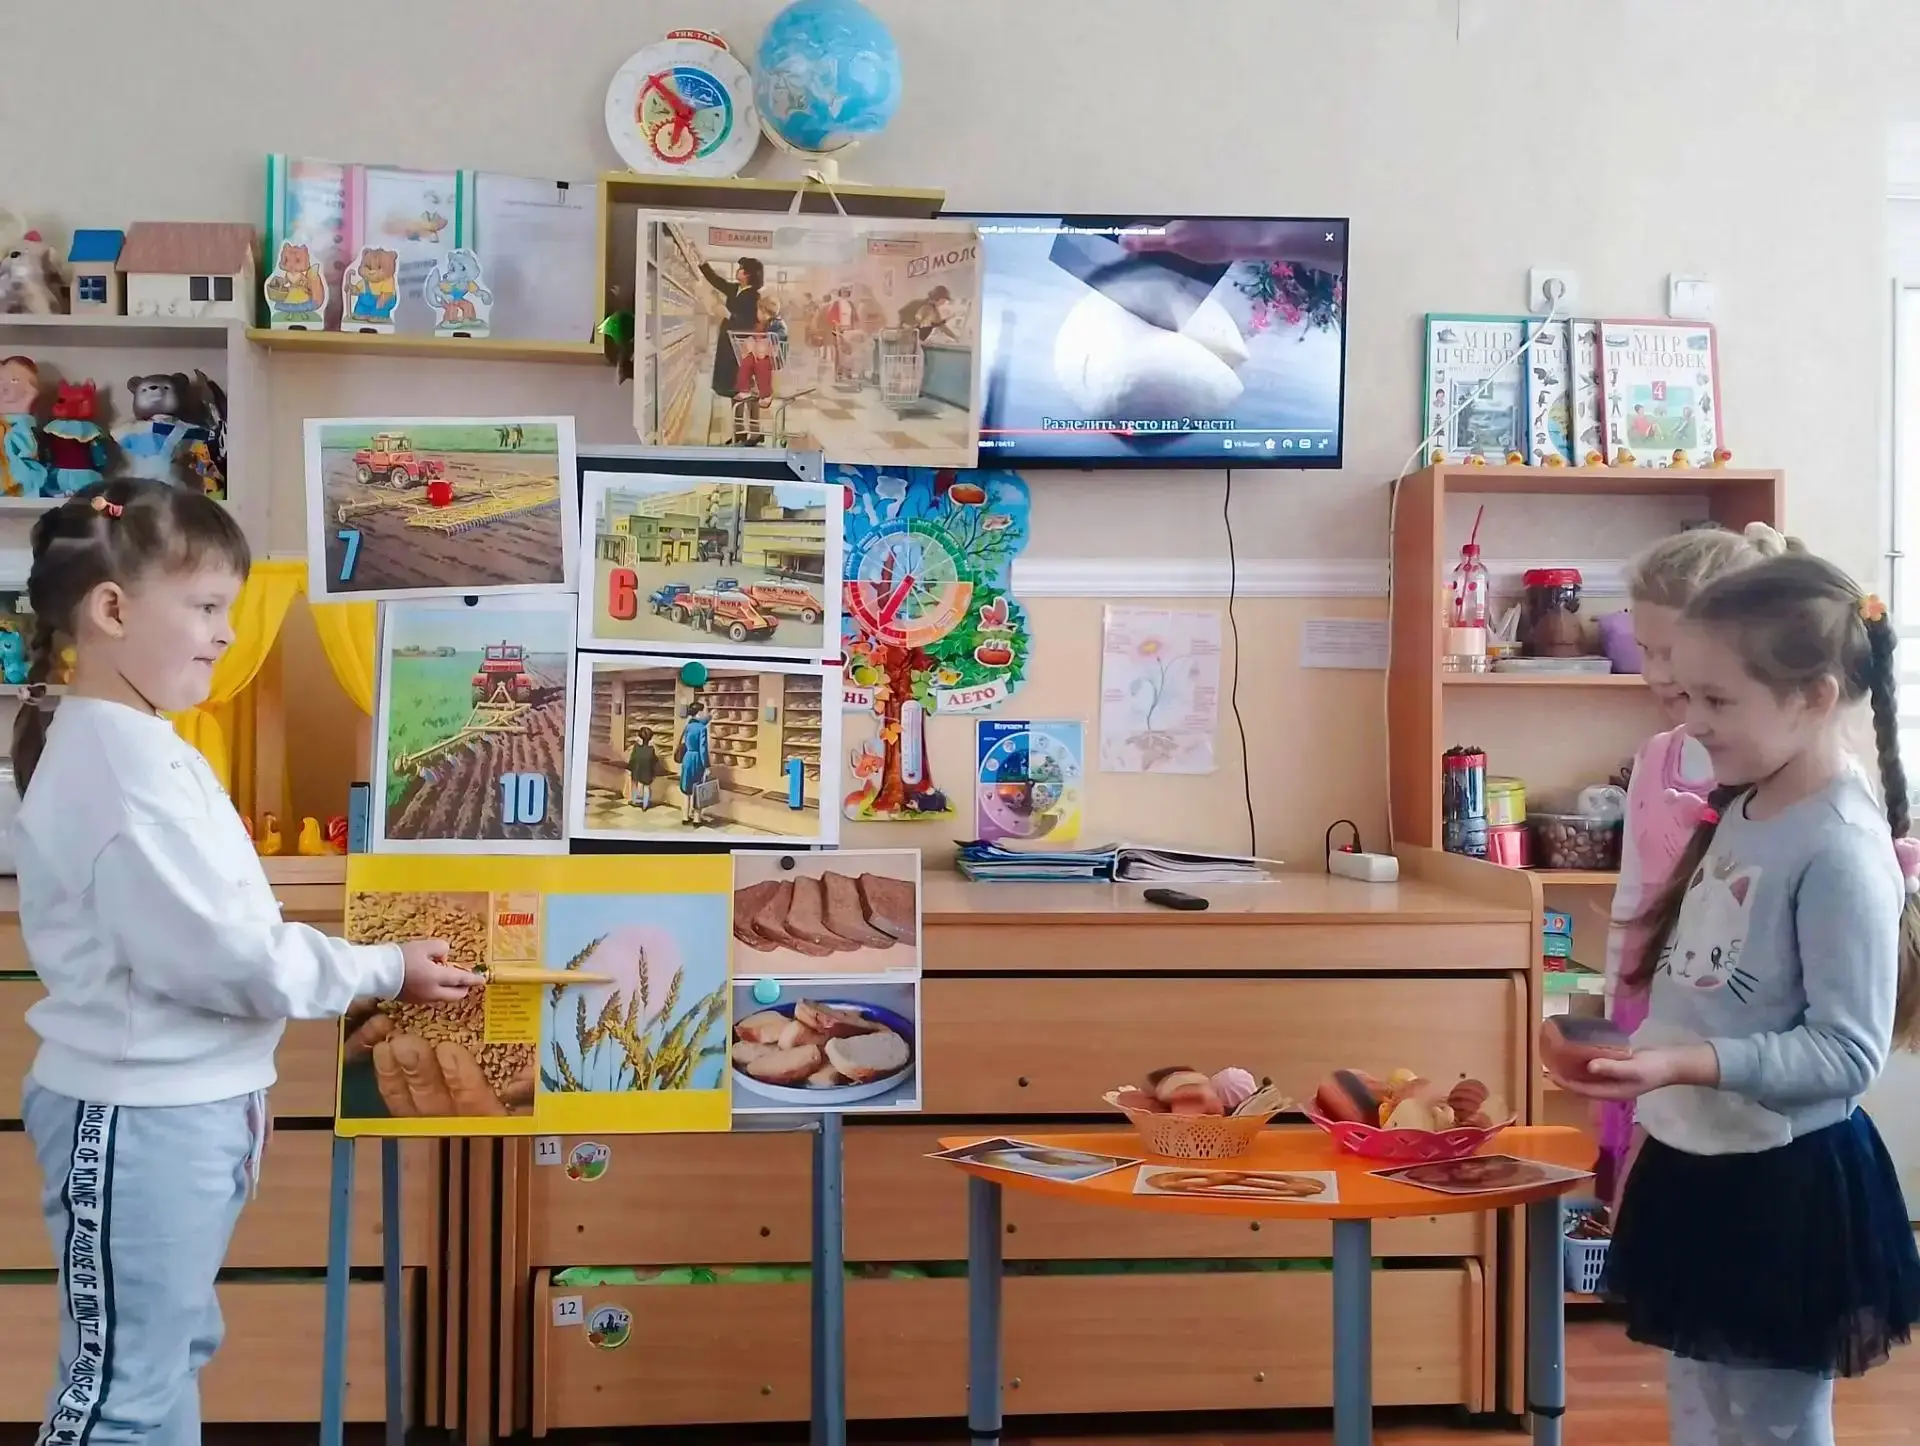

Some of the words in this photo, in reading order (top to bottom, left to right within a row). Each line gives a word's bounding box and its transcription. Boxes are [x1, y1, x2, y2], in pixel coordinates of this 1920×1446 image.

[1633, 334, 1681, 353] МИР
[1626, 350, 1706, 368] ЧЕЛОВЕК
[1042, 416, 1117, 432] Разделить
[1119, 420, 1158, 431] тесто
[1161, 420, 1179, 431] на
[1182, 417, 1192, 431] 2
[1194, 420, 1235, 431] части
[337, 528, 362, 583] 7
[608, 567, 638, 620] 6
[947, 686, 996, 706] ЛЕТО
[785, 757, 804, 810] 1
[499, 772, 548, 825] 10
[81, 1104, 107, 1144] HOUSE
[76, 1147, 99, 1163] OF
[539, 1142, 557, 1155] 11
[72, 1231, 96, 1270] HOUSE
[73, 1273, 98, 1290] OF
[559, 1302, 577, 1316] 12
